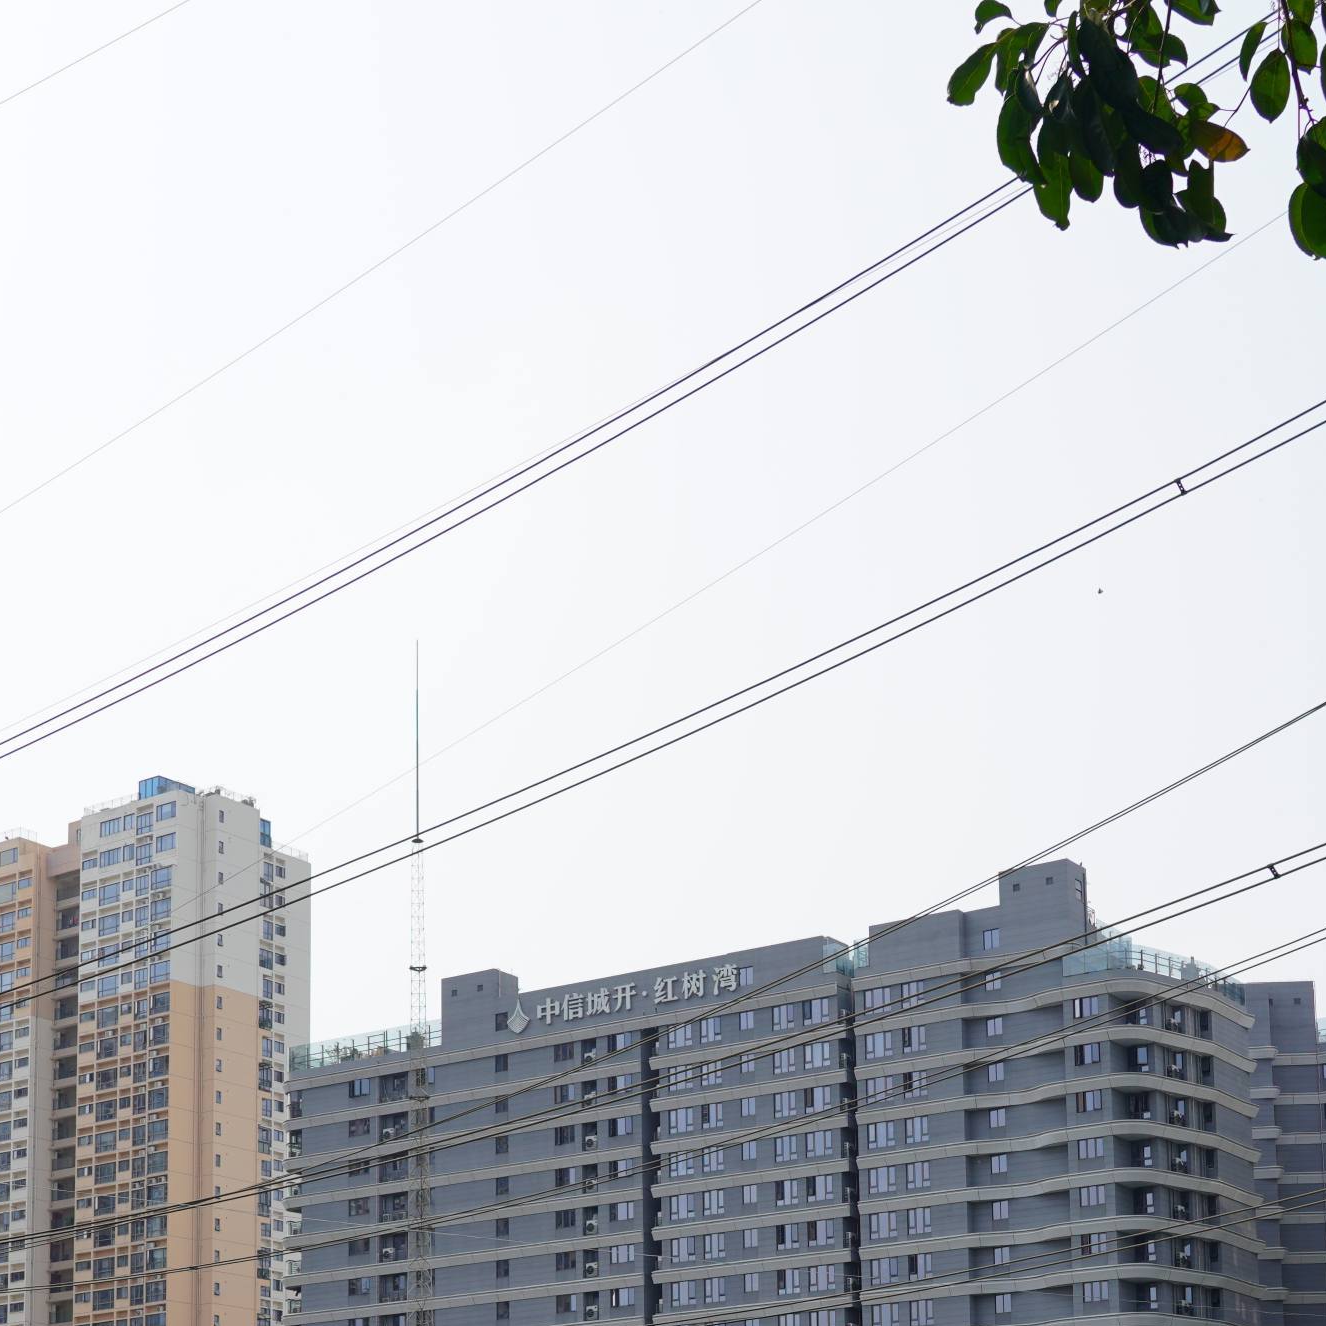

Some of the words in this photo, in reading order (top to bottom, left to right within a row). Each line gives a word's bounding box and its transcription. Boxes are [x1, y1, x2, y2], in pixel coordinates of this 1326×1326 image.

[536, 964, 738, 1025] 中信城开·红树湾
